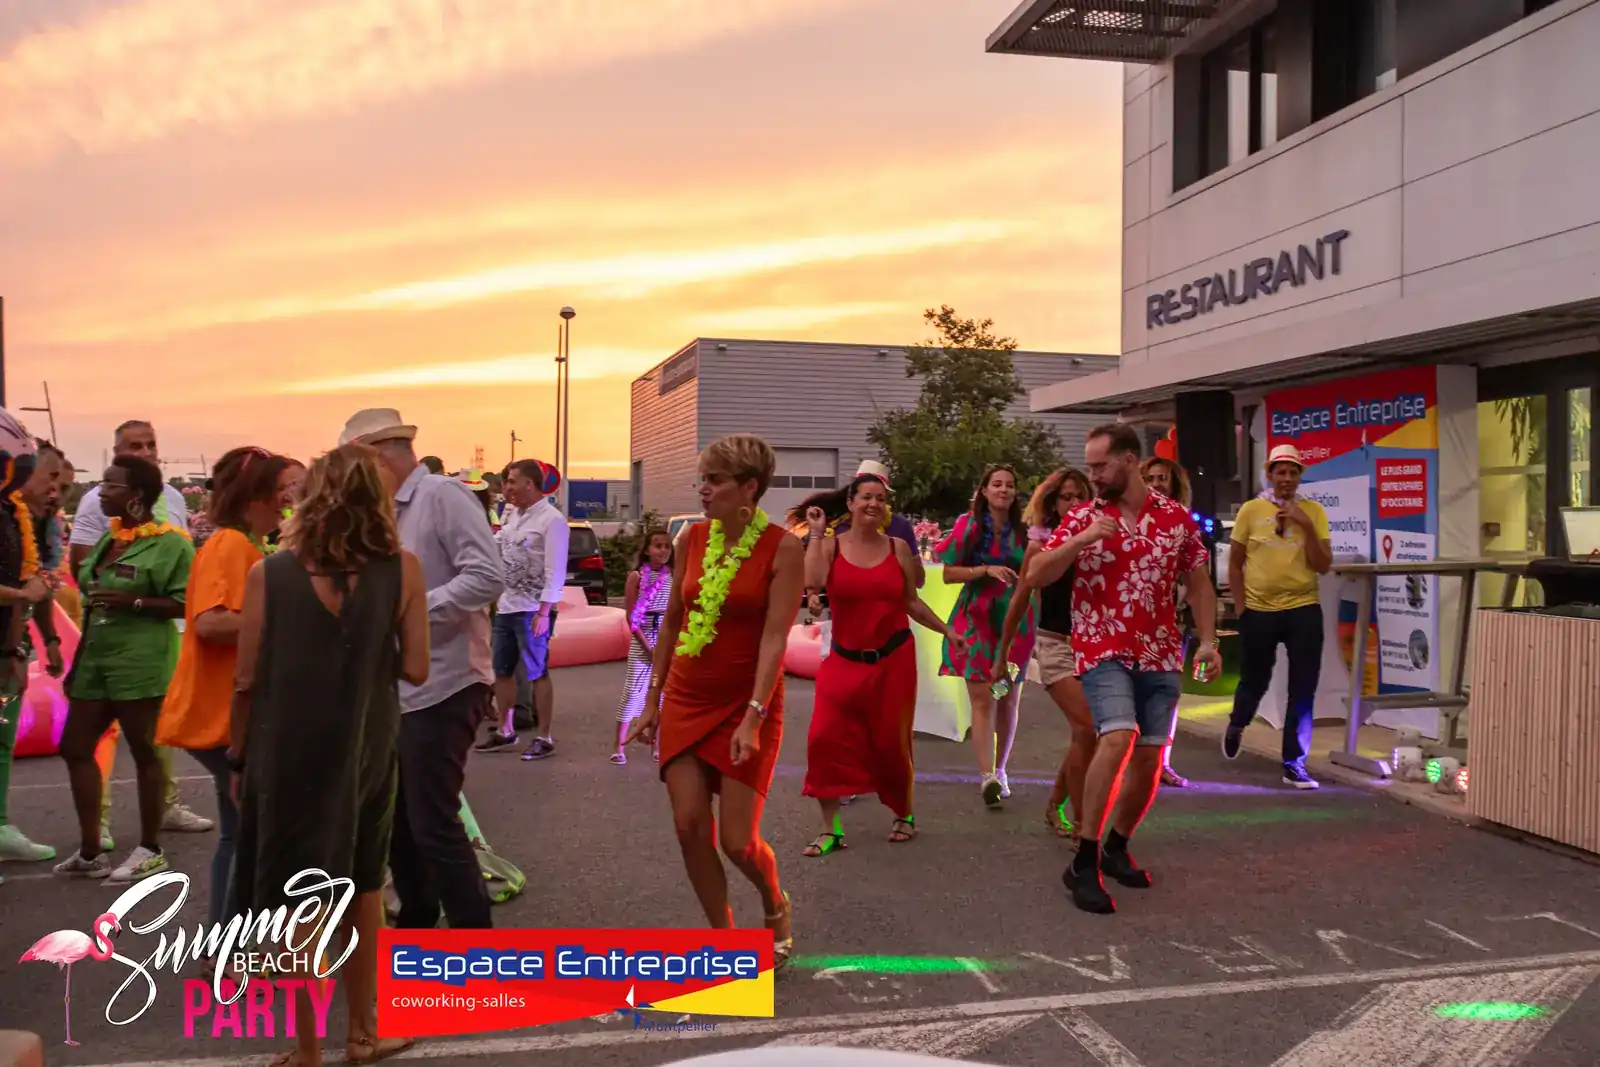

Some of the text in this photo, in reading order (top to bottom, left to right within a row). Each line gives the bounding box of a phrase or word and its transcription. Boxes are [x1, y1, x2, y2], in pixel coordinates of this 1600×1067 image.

[1146, 229, 1351, 330] RESTAURANT
[1272, 397, 1425, 436] Espace Entreprise
[1300, 446, 1331, 460] pellier
[1328, 517, 1367, 536] oworking
